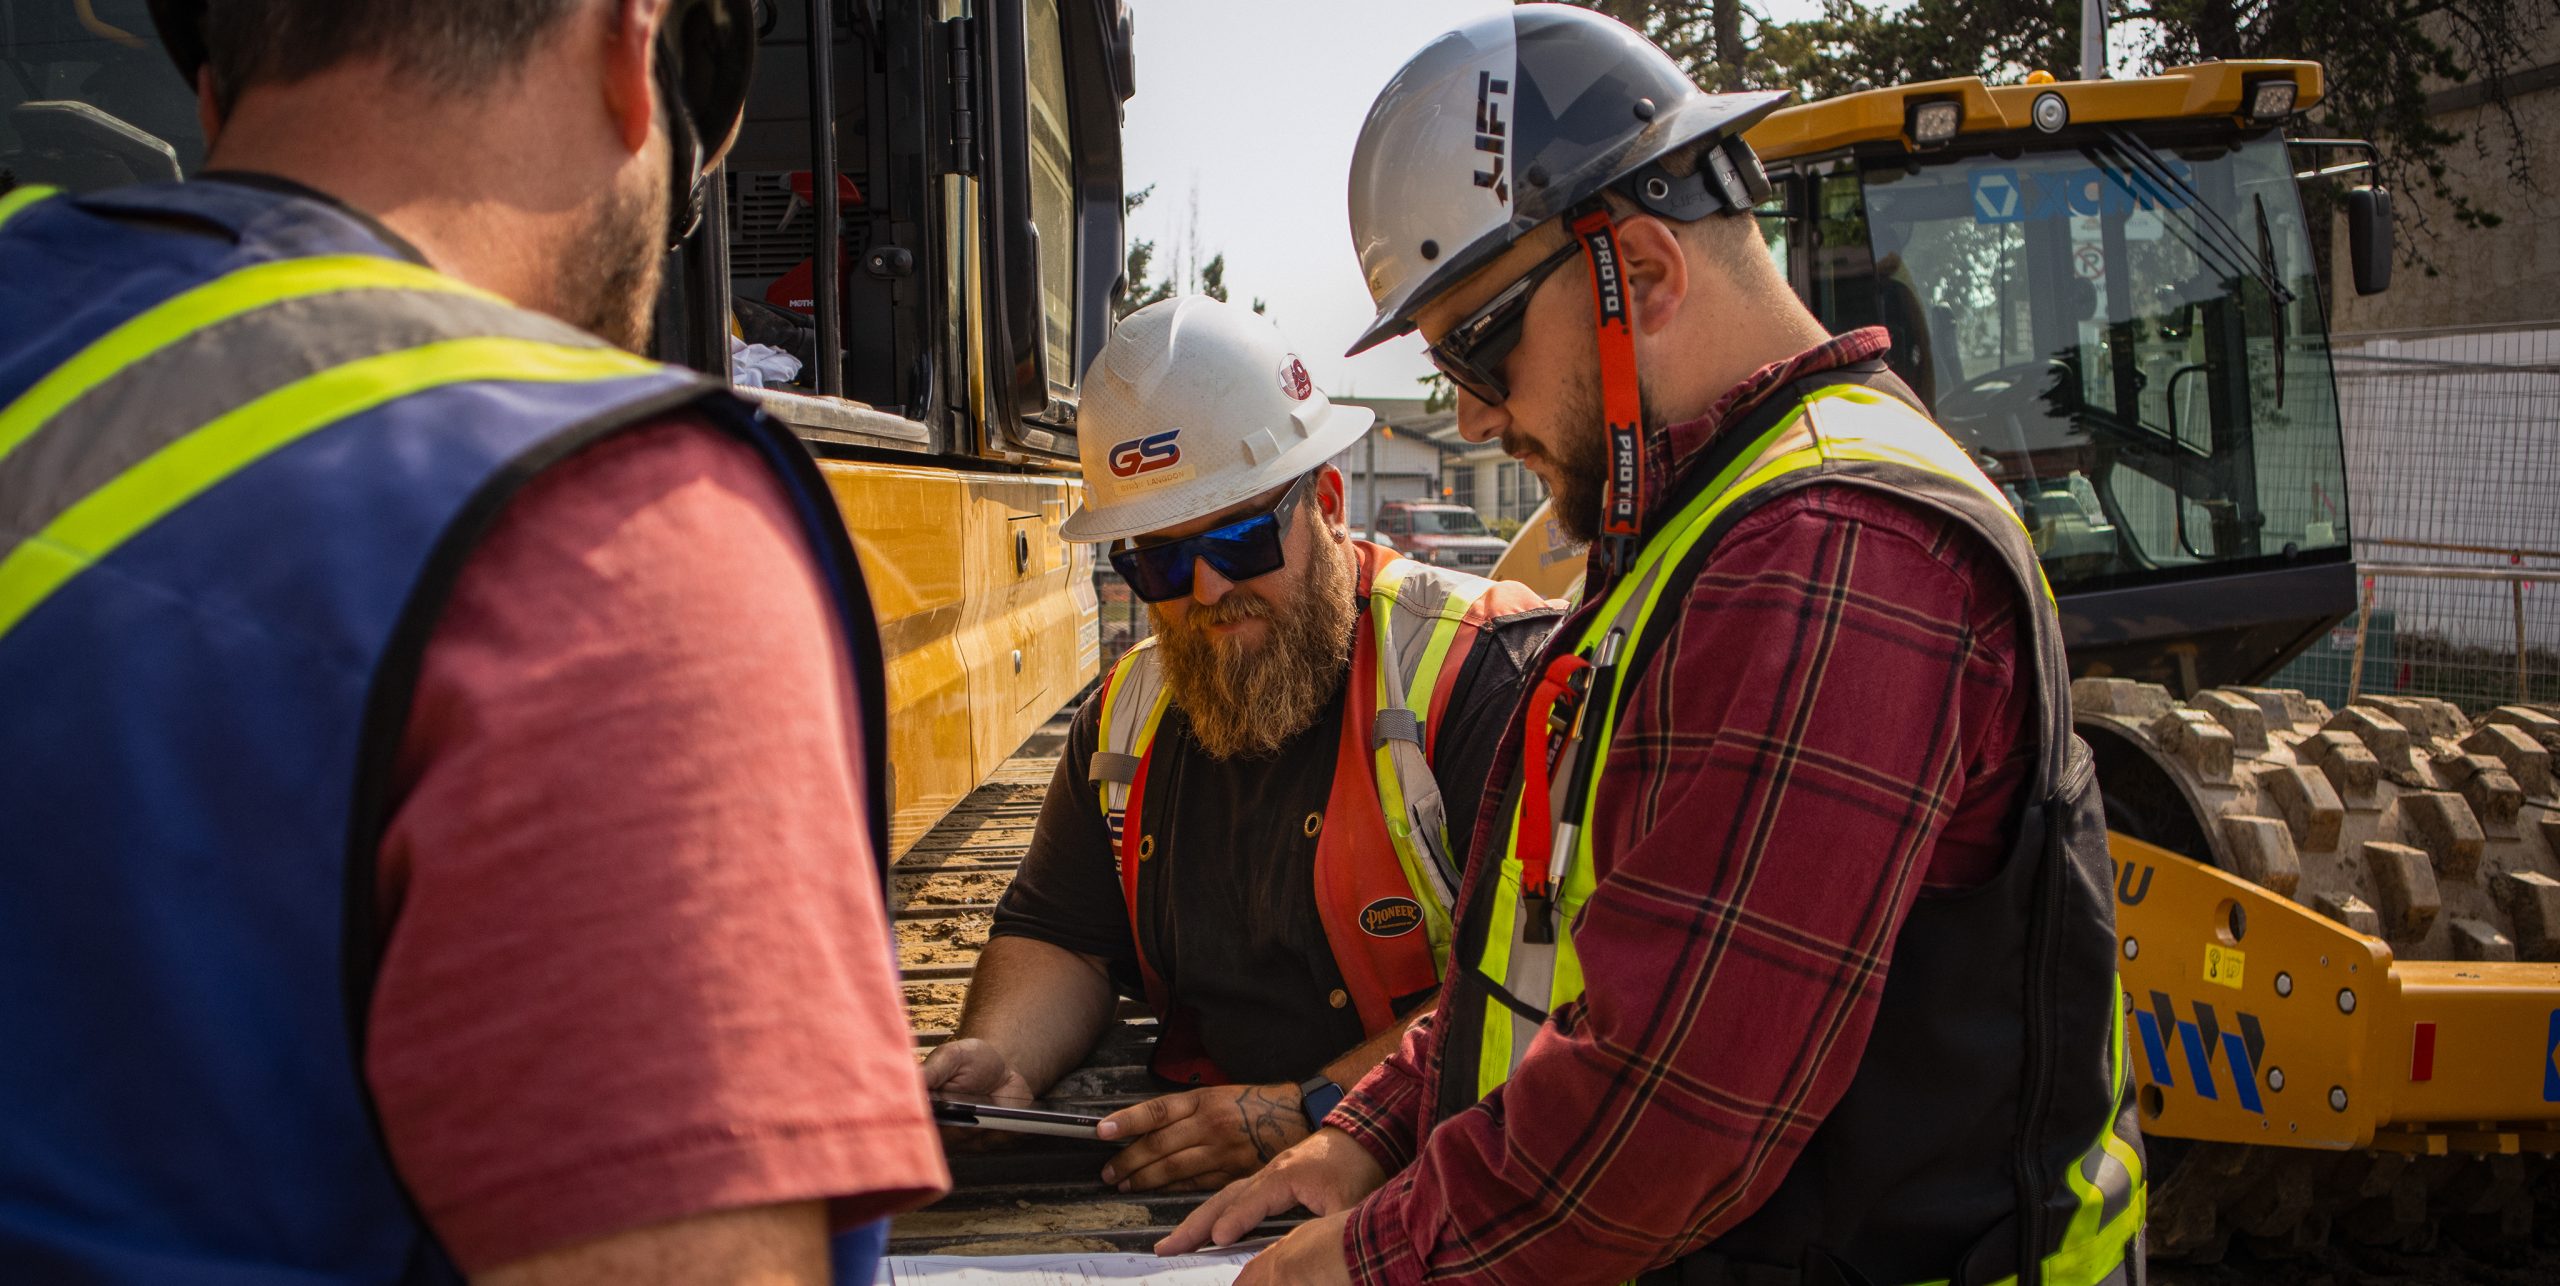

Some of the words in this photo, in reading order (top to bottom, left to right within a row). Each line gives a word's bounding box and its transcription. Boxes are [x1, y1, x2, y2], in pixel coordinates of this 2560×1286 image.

[1474, 70, 1509, 208] LIFT
[789, 299, 814, 308] MOTH
[1593, 235, 1620, 312] PROTO
[1108, 428, 1181, 478] GS
[1618, 434, 1634, 515] PROTO
[1366, 905, 1417, 930] PIONEER
